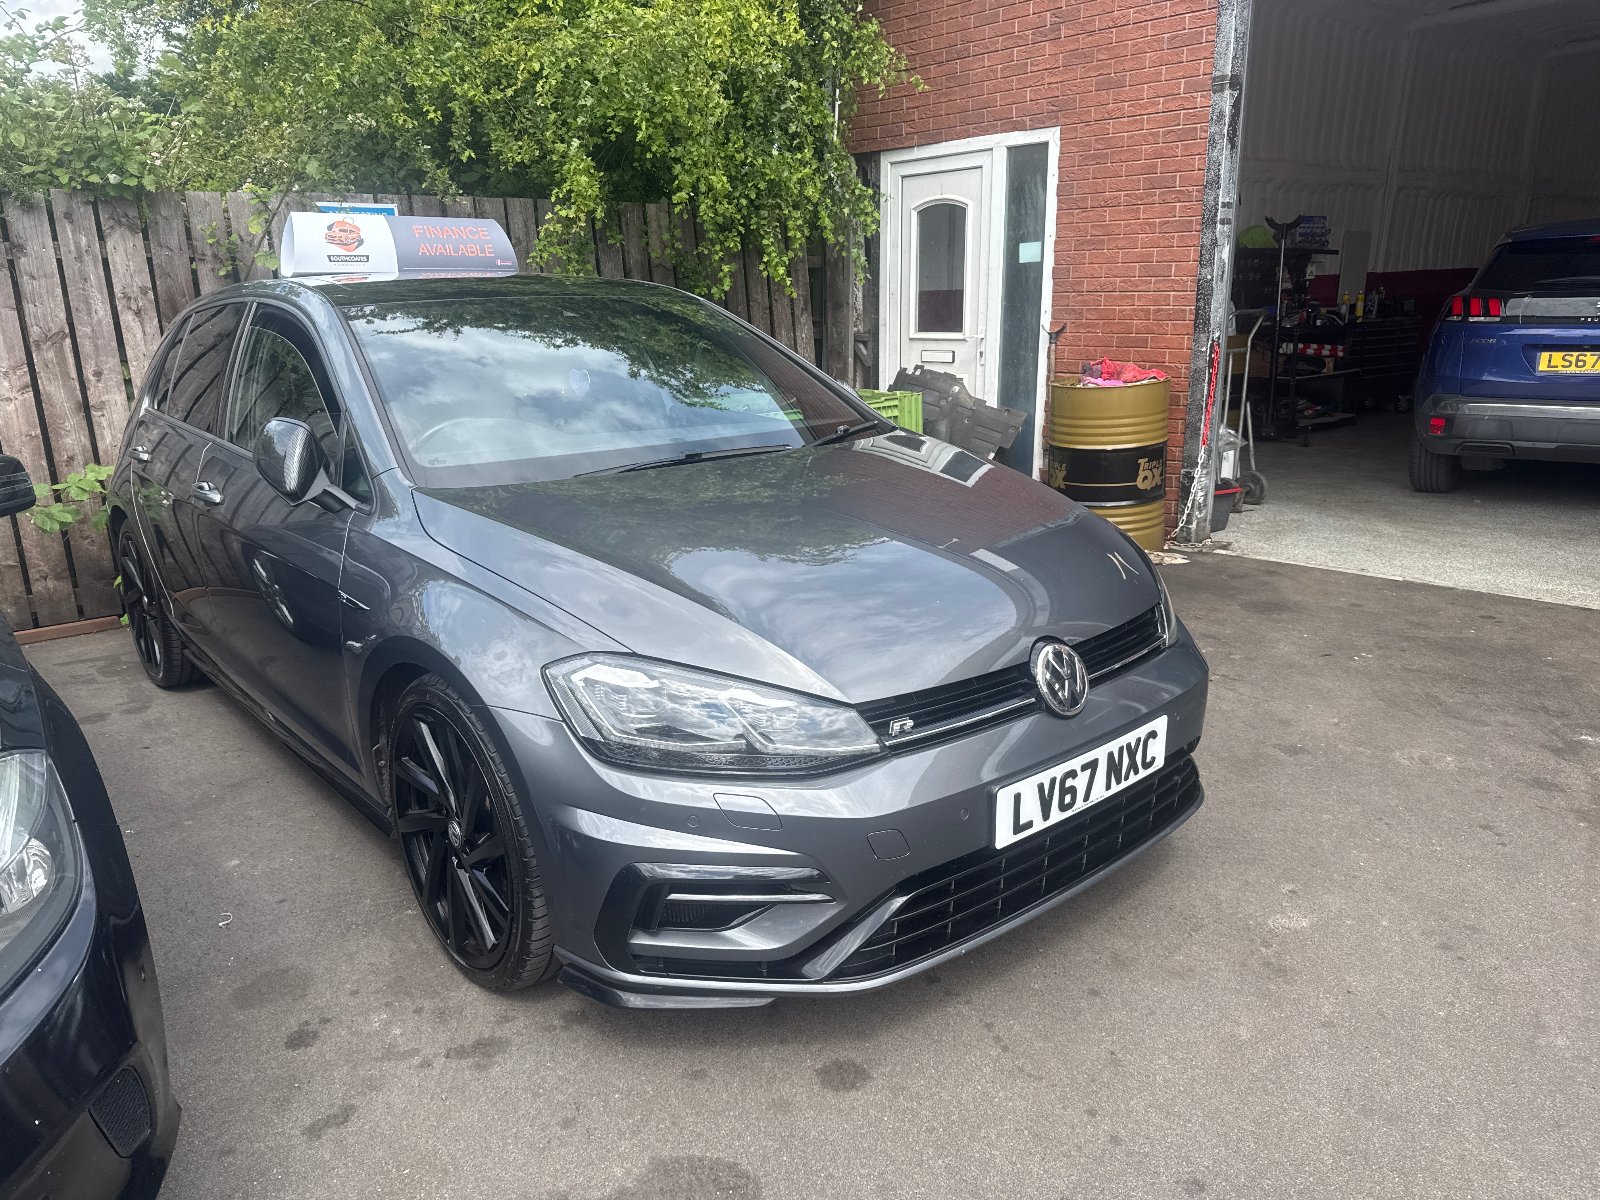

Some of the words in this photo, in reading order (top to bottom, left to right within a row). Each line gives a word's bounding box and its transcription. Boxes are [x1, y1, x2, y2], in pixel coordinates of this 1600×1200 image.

[412, 225, 491, 240] FINANCE
[419, 243, 495, 257] AVAILABLE
[1547, 353, 1600, 369] LS67
[1012, 757, 1099, 836] LV67
[1105, 729, 1158, 791] NXC
